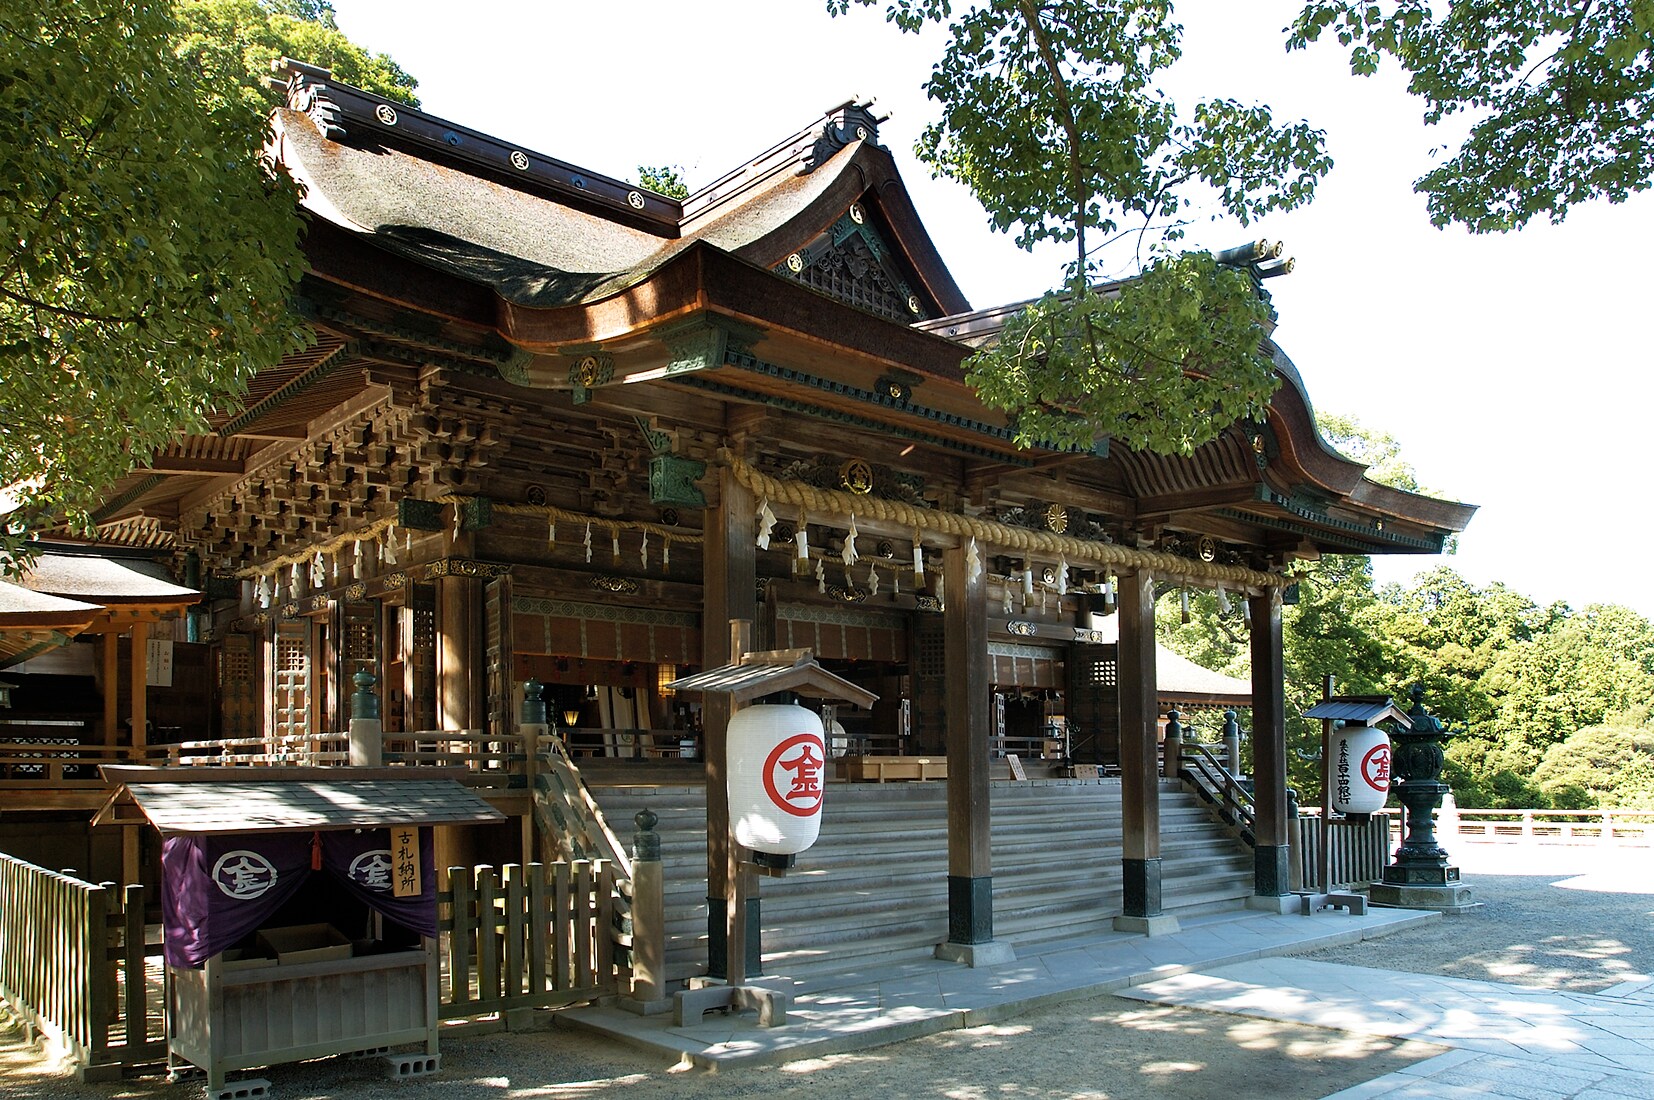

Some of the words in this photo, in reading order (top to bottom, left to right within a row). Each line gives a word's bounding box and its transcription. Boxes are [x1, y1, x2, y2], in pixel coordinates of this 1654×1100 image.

[778, 744, 824, 801] 金
[1369, 750, 1391, 783] 金
[221, 855, 271, 895] 金
[398, 831, 416, 894] 古札納所
